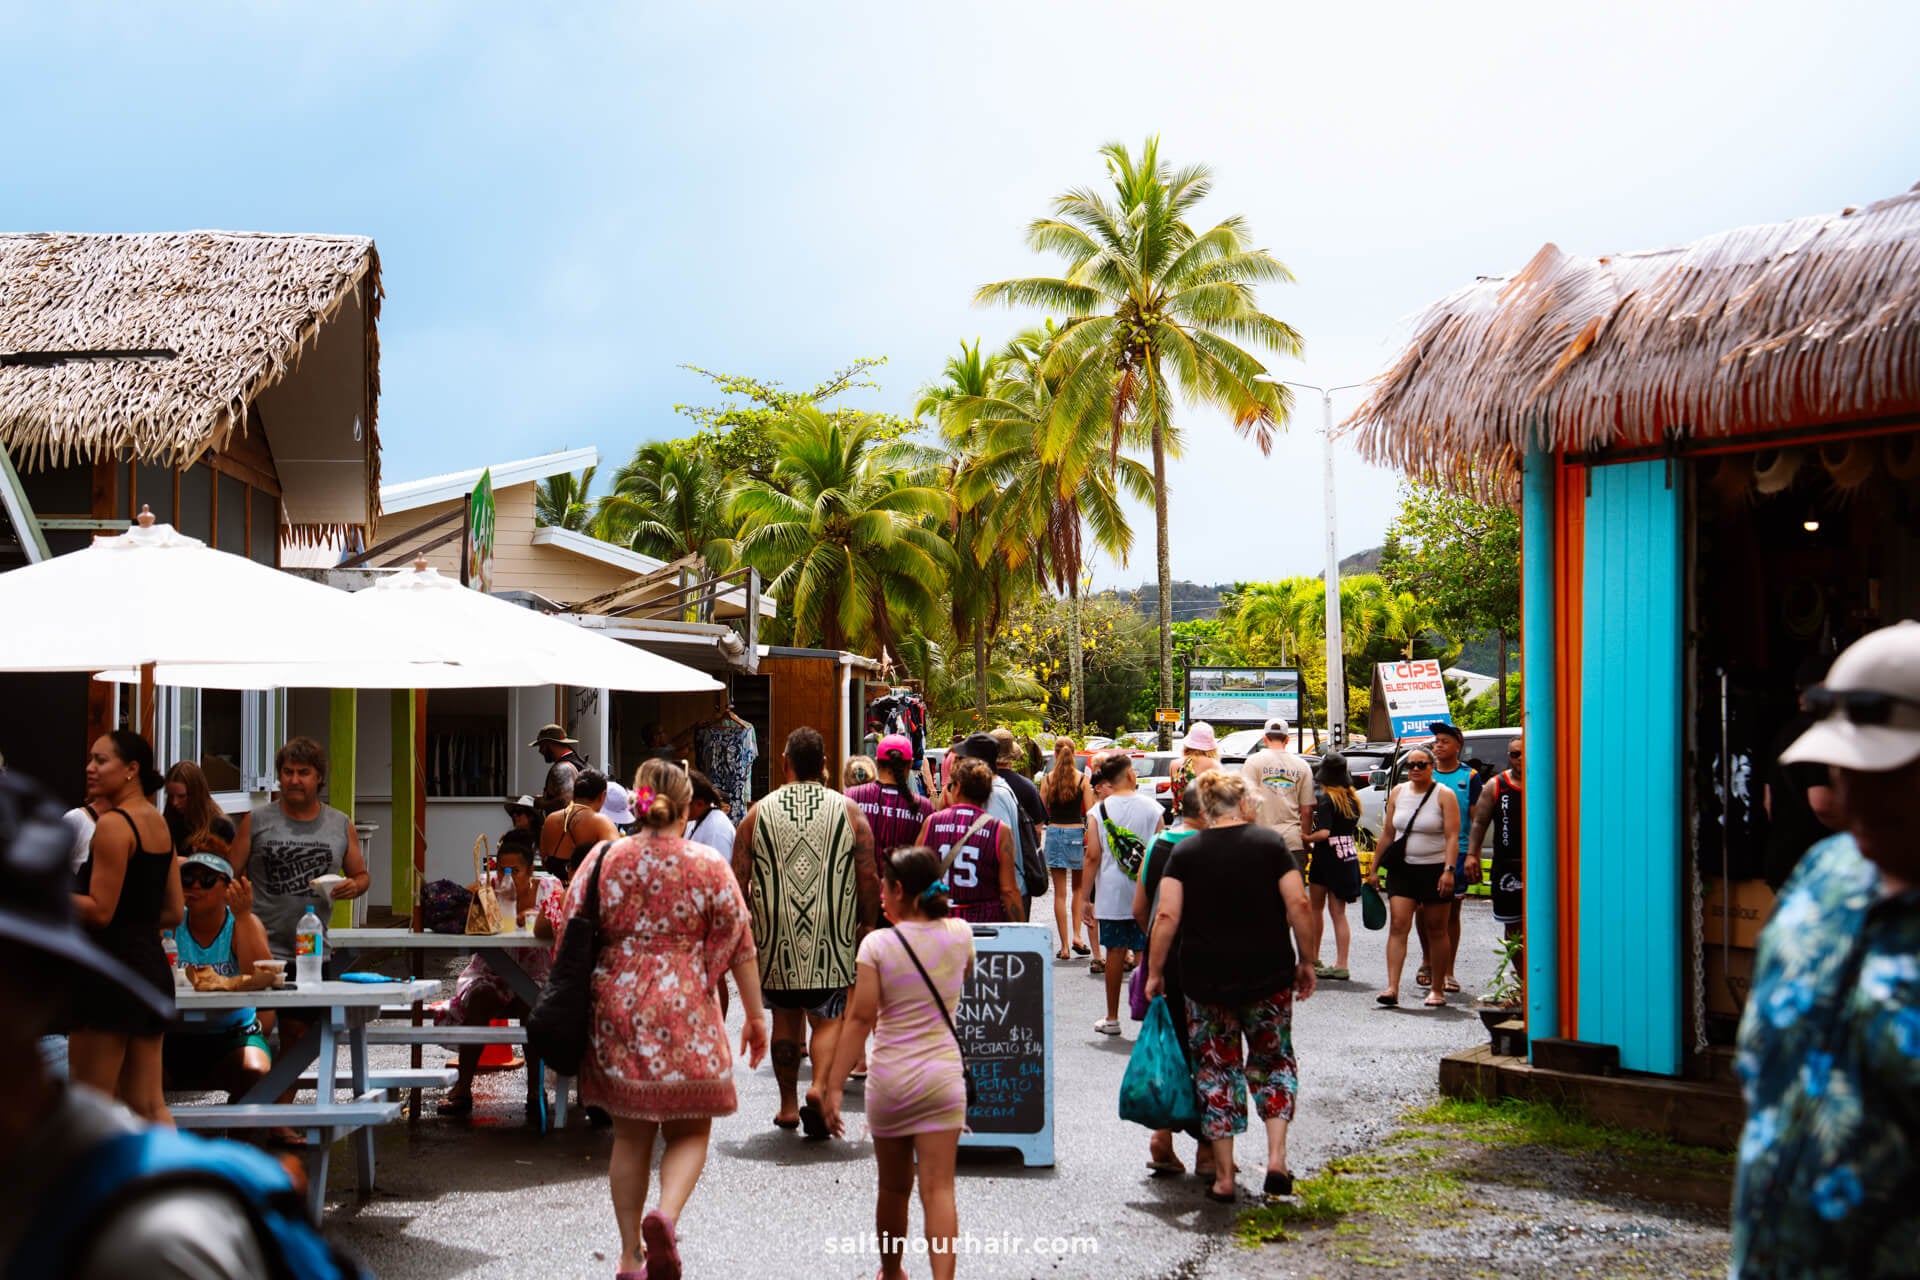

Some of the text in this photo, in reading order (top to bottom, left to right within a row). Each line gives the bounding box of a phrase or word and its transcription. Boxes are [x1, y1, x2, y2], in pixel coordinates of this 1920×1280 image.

[1396, 662, 1439, 678] CIPS
[1385, 681, 1442, 693] ELECTRONICS
[858, 802, 880, 815] OITŪ
[881, 806, 893, 817] TE
[1501, 794, 1510, 847] CHICAGO
[973, 954, 1025, 979] KED
[961, 982, 1000, 1000] LIN
[955, 1001, 1010, 1025] RNAY
[956, 1025, 1034, 1041] EPE $12
[971, 1042, 1020, 1055] POTATO
[976, 1077, 1033, 1092] POTATO
